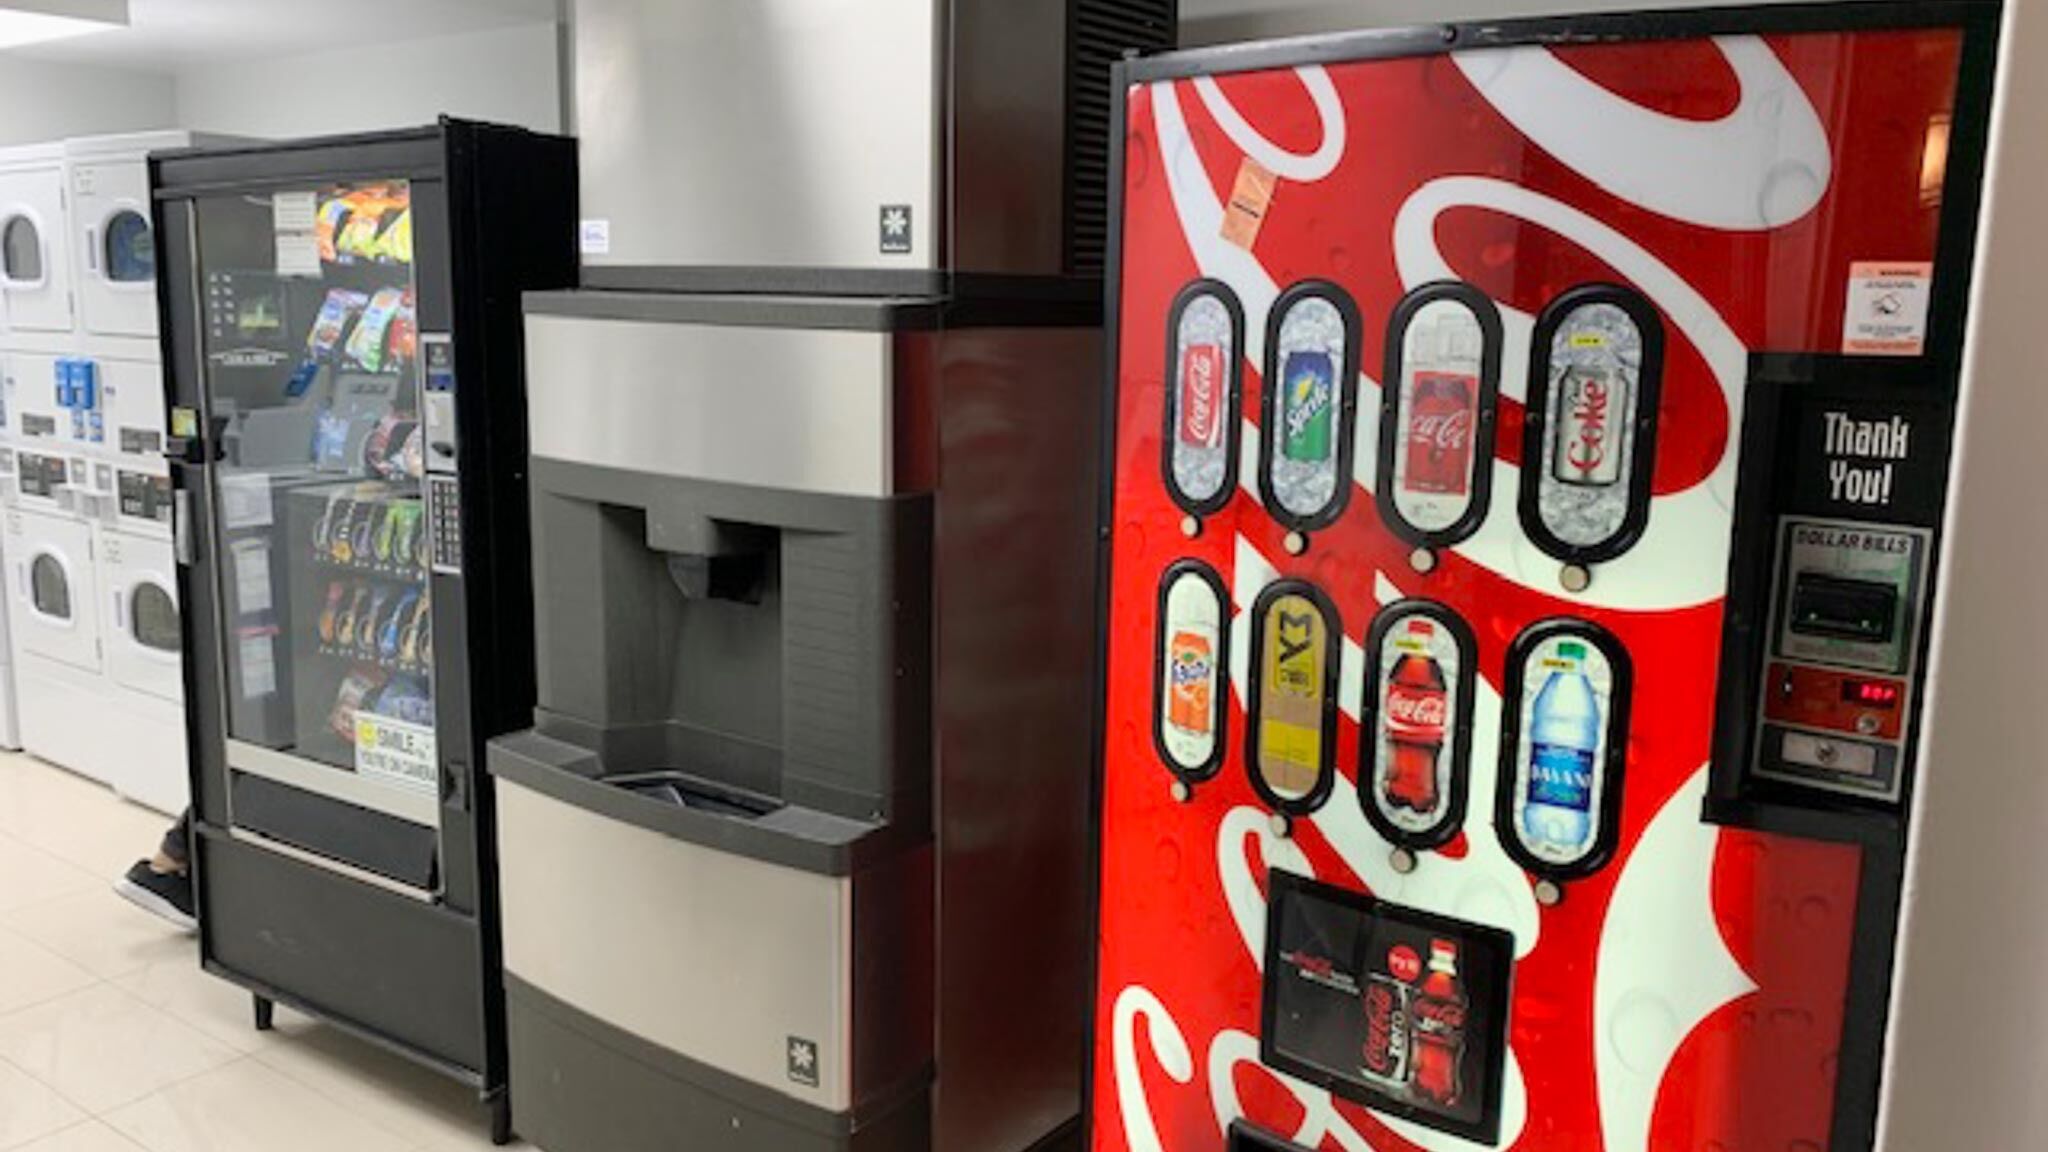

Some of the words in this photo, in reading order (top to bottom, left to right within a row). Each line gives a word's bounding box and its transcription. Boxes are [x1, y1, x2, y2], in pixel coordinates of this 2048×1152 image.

[1286, 376, 1329, 437] Sprite
[1567, 379, 1607, 476] Coke
[1824, 412, 1909, 458] Thank
[1829, 460, 1892, 504] You!
[1797, 529, 1859, 548] DOLLAR
[1861, 534, 1908, 554] BILLS
